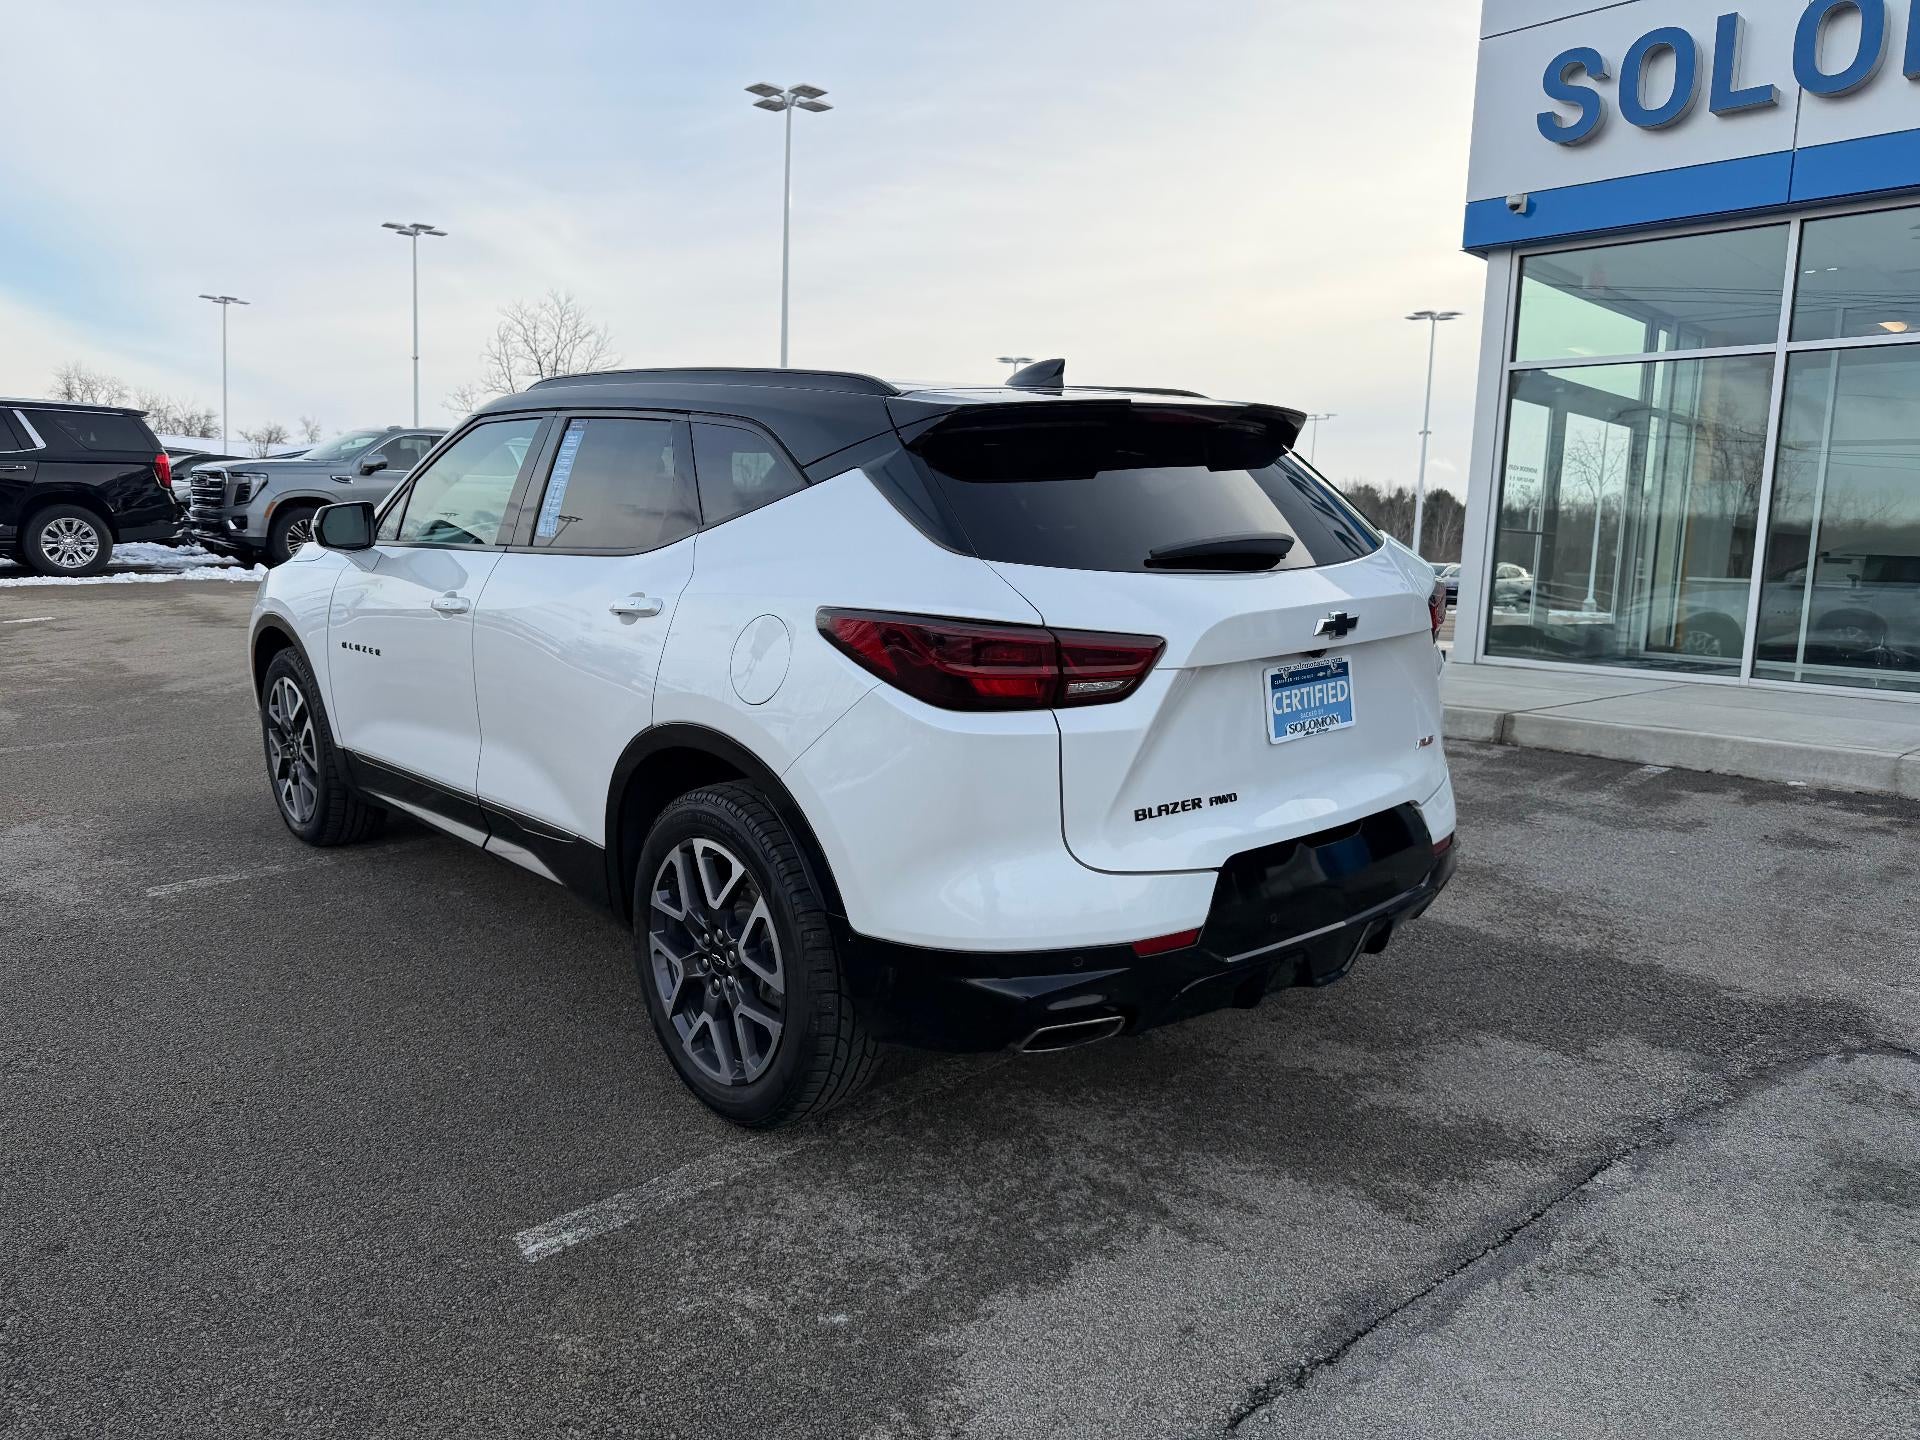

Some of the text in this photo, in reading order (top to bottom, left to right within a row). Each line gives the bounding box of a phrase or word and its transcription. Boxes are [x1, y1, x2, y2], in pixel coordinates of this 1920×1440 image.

[1537, 0, 1920, 146] SOLO
[341, 641, 381, 656] BLAZER
[1273, 680, 1348, 714] CERTIFIED
[1288, 713, 1339, 734] SOLOMON
[1134, 792, 1238, 821] BLAZER AWD
